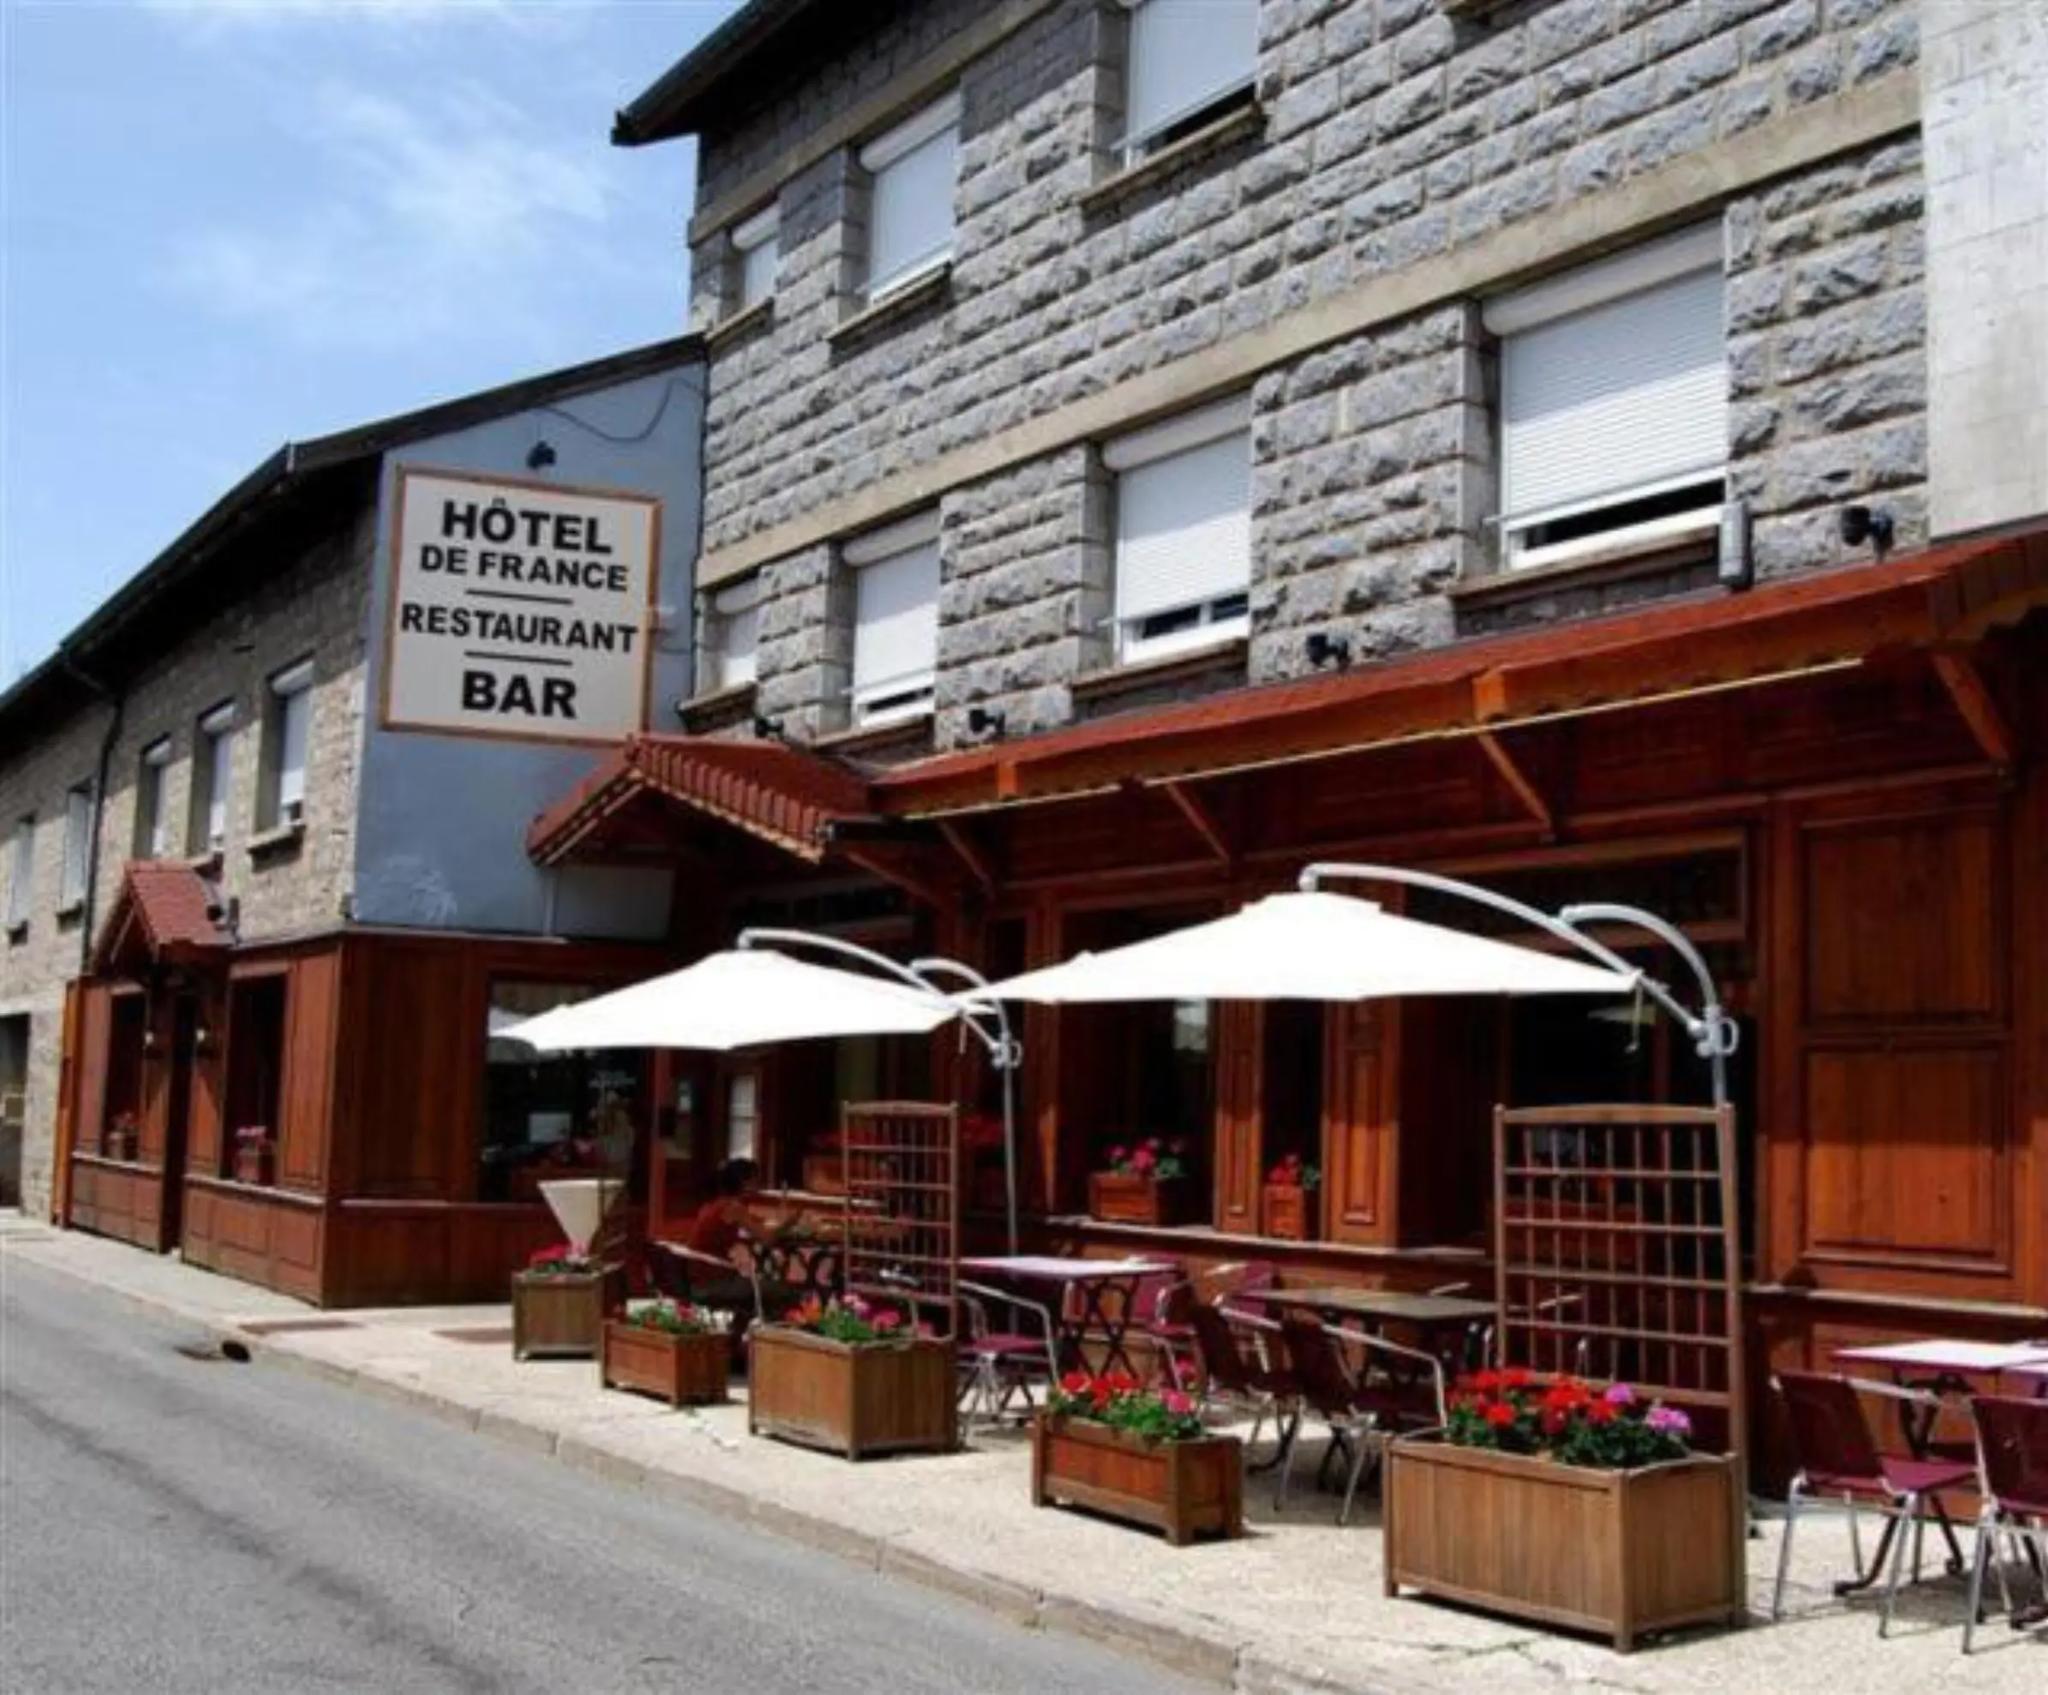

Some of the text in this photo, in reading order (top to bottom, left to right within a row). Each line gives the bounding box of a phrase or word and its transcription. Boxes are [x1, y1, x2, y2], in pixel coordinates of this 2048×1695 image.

[441, 497, 612, 555] HÔTEL
[420, 544, 629, 592] DE FRANCE
[401, 603, 639, 653] RESTAURANT
[461, 670, 577, 719] BAR
